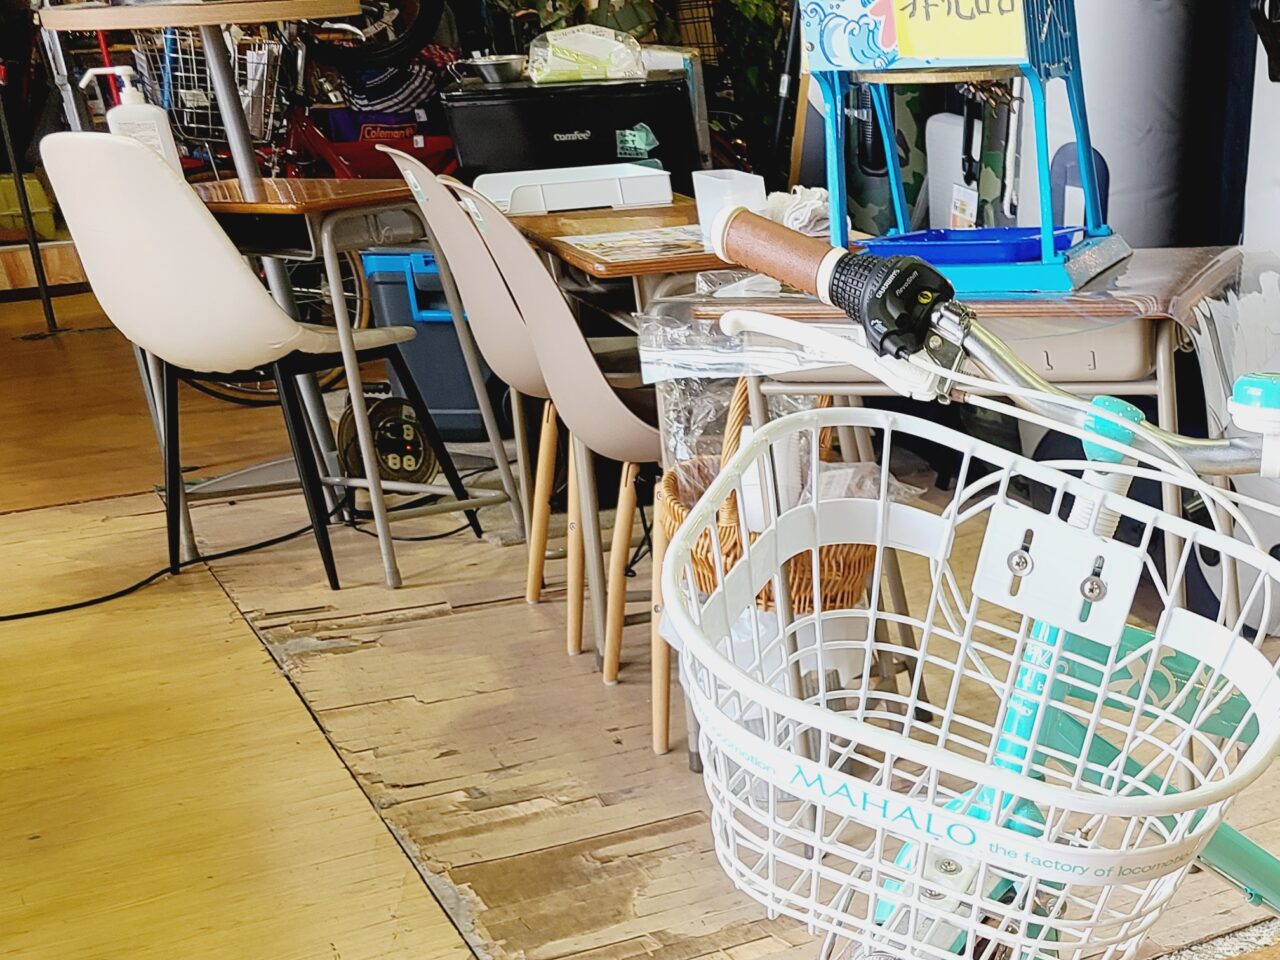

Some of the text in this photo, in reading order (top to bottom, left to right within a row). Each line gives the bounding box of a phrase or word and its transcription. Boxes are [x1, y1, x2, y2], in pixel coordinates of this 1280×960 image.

[875, 269, 900, 299] SHIMANO
[790, 764, 976, 846] MAHALO
[988, 842, 1017, 859] the
[1024, 851, 1089, 878] factory
[1093, 866, 1114, 877] of
